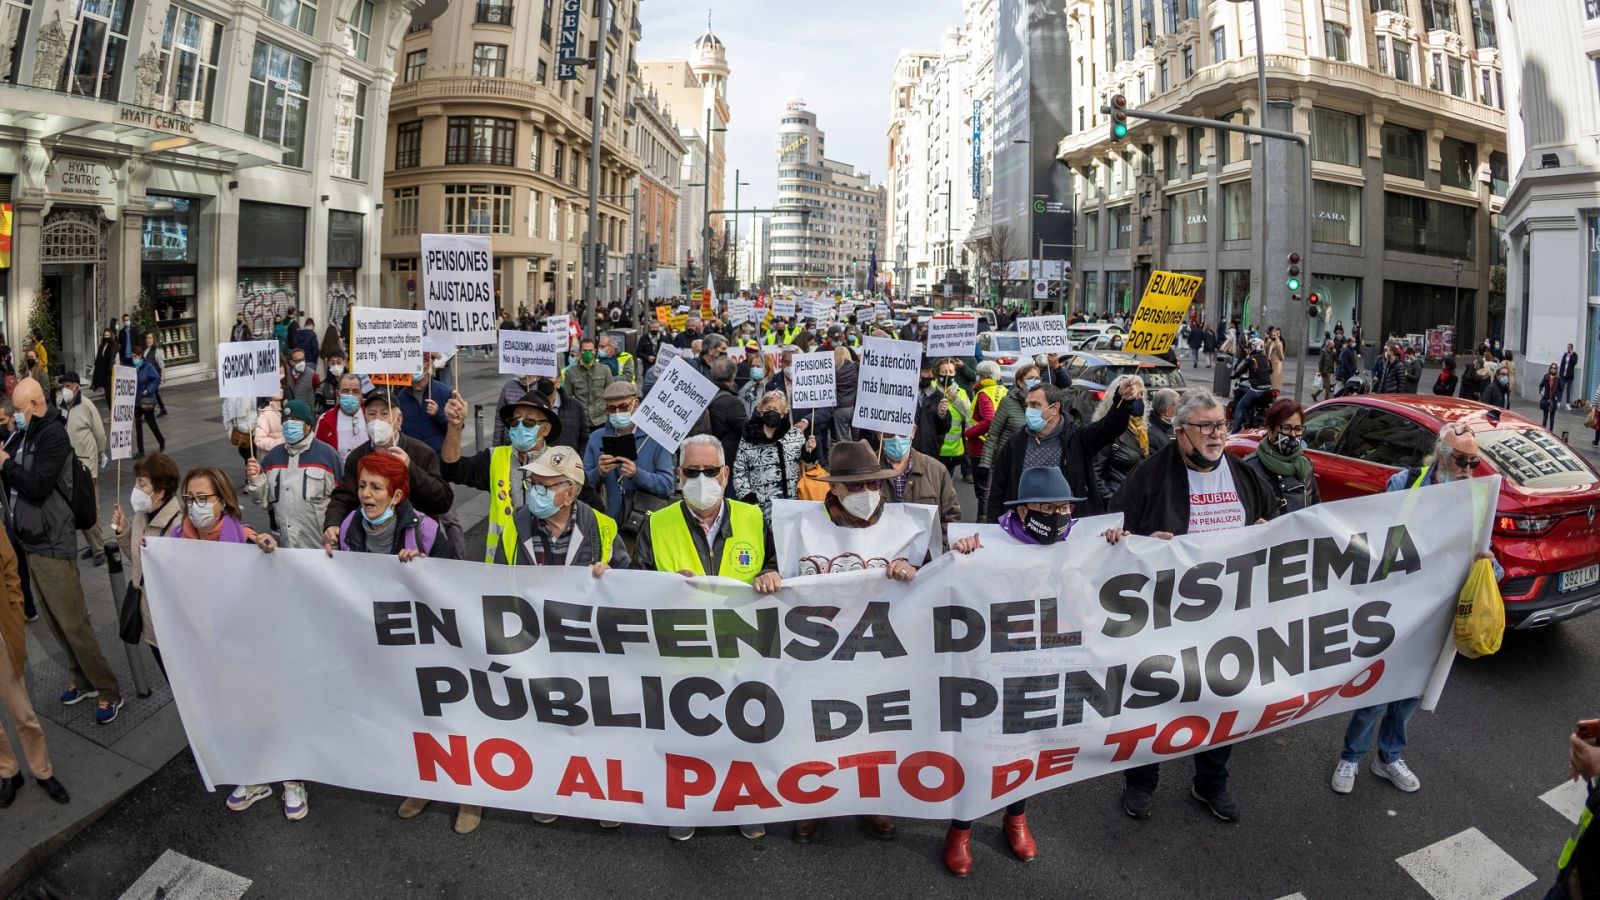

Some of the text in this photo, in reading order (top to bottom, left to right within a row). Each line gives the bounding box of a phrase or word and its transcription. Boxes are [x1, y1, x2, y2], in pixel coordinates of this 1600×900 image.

[120, 107, 195, 134] HYATT CENTRIC
[68, 161, 96, 174] HYATT
[62, 173, 101, 186] CENTRIC
[1187, 214, 1208, 224] ZARA
[1318, 211, 1346, 221] ZARA
[1121, 224, 1132, 233] ZAR
[426, 250, 488, 275] ¡PENSIONES
[429, 280, 490, 302] AJUSTADAS
[1145, 274, 1199, 297] ¡BLINDAR
[357, 320, 368, 330] Nos
[428, 310, 449, 331] CON
[450, 312, 465, 332] EL
[466, 311, 496, 332] I.P.C.!
[1134, 305, 1184, 325] pensiones
[356, 333, 421, 347] siempre con mucho dinero
[1020, 335, 1067, 348] ENCARECEN!
[1125, 330, 1175, 351] POR LEY!
[356, 351, 368, 363] para
[503, 354, 510, 363] No
[516, 355, 520, 364] la
[794, 357, 832, 374] ¡PENSIONES
[862, 349, 918, 374] Más atención,
[663, 367, 708, 408] ¡Ya gobierne
[795, 373, 833, 387] AJUSTADAS
[861, 376, 915, 401] más humana,
[794, 391, 810, 402] CON
[810, 391, 818, 401] EL
[656, 389, 693, 425] tal o cual,
[858, 406, 913, 425] en sucursales.
[640, 404, 685, 443] mi pensión va!
[1030, 517, 1052, 532] SANIDAD
[1565, 565, 1598, 587] 3921 LNY
[373, 601, 463, 648] EN
[482, 596, 909, 661] DEFENSA
[933, 598, 1083, 654] DEL
[1099, 525, 1422, 637] SISTEMA
[416, 662, 785, 743] PÚBLICO
[811, 690, 913, 743] DE
[939, 601, 1396, 734] PENSIONES
[413, 732, 533, 791] NO
[557, 757, 643, 803] AL
[666, 751, 966, 812] PACTO
[992, 747, 1079, 799] DE
[1104, 658, 1386, 762] TOLEDO
